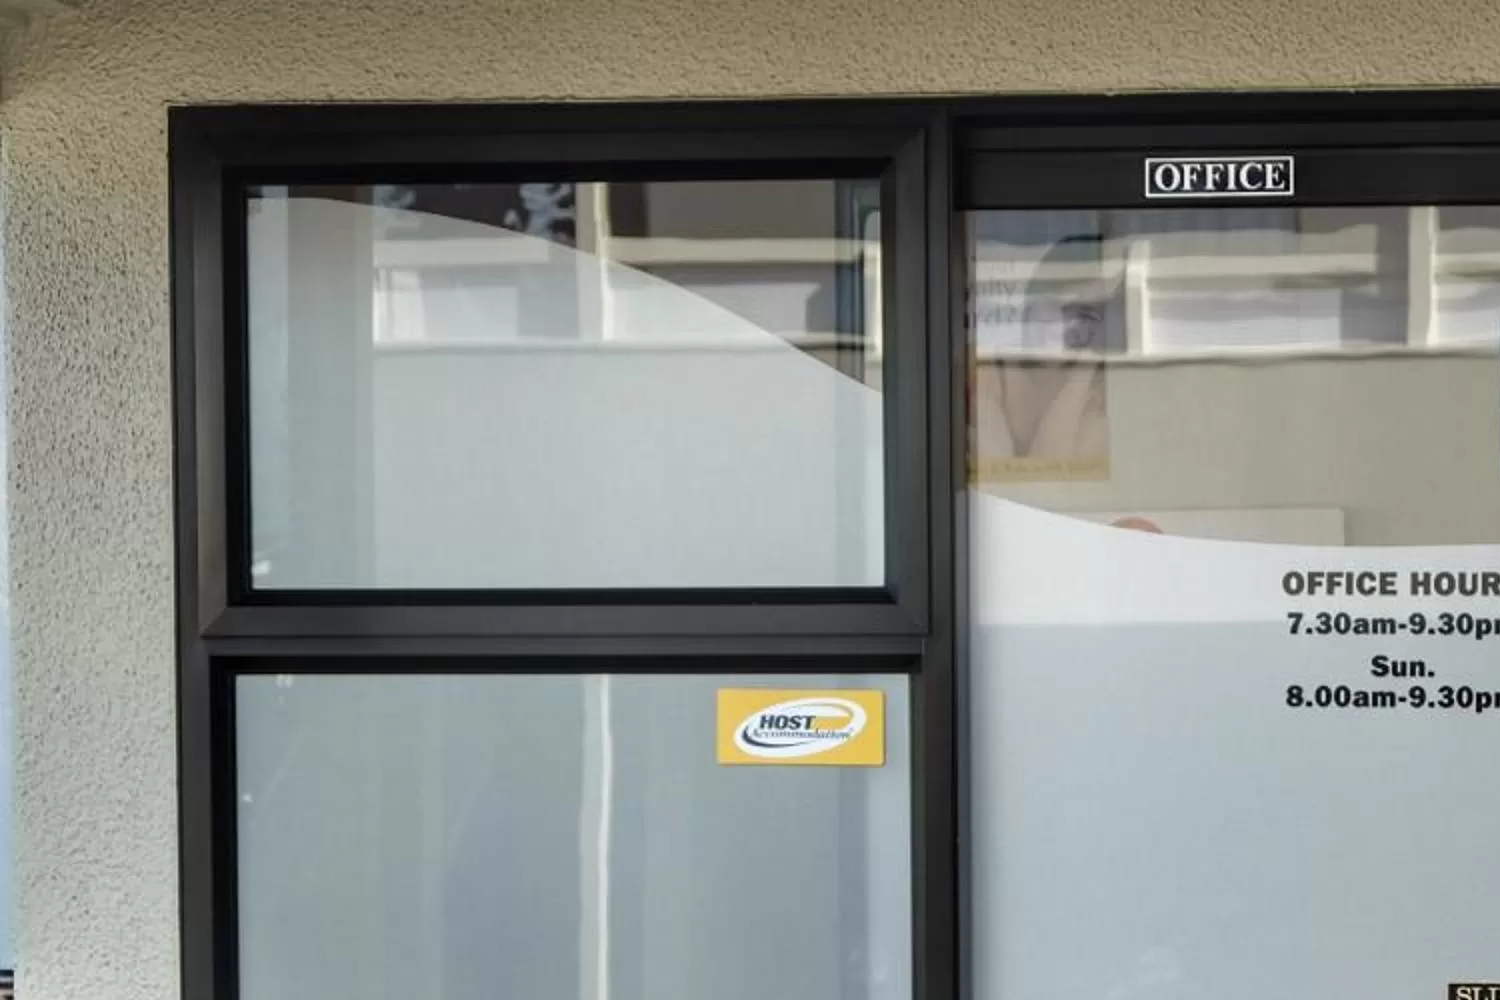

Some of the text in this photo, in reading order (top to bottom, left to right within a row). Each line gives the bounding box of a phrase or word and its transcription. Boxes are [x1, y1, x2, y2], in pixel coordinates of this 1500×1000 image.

[1154, 162, 1285, 191] OFFICE
[1282, 571, 1397, 596] OFFICE
[1370, 655, 1435, 677] Sun.
[759, 715, 816, 730] HOST
